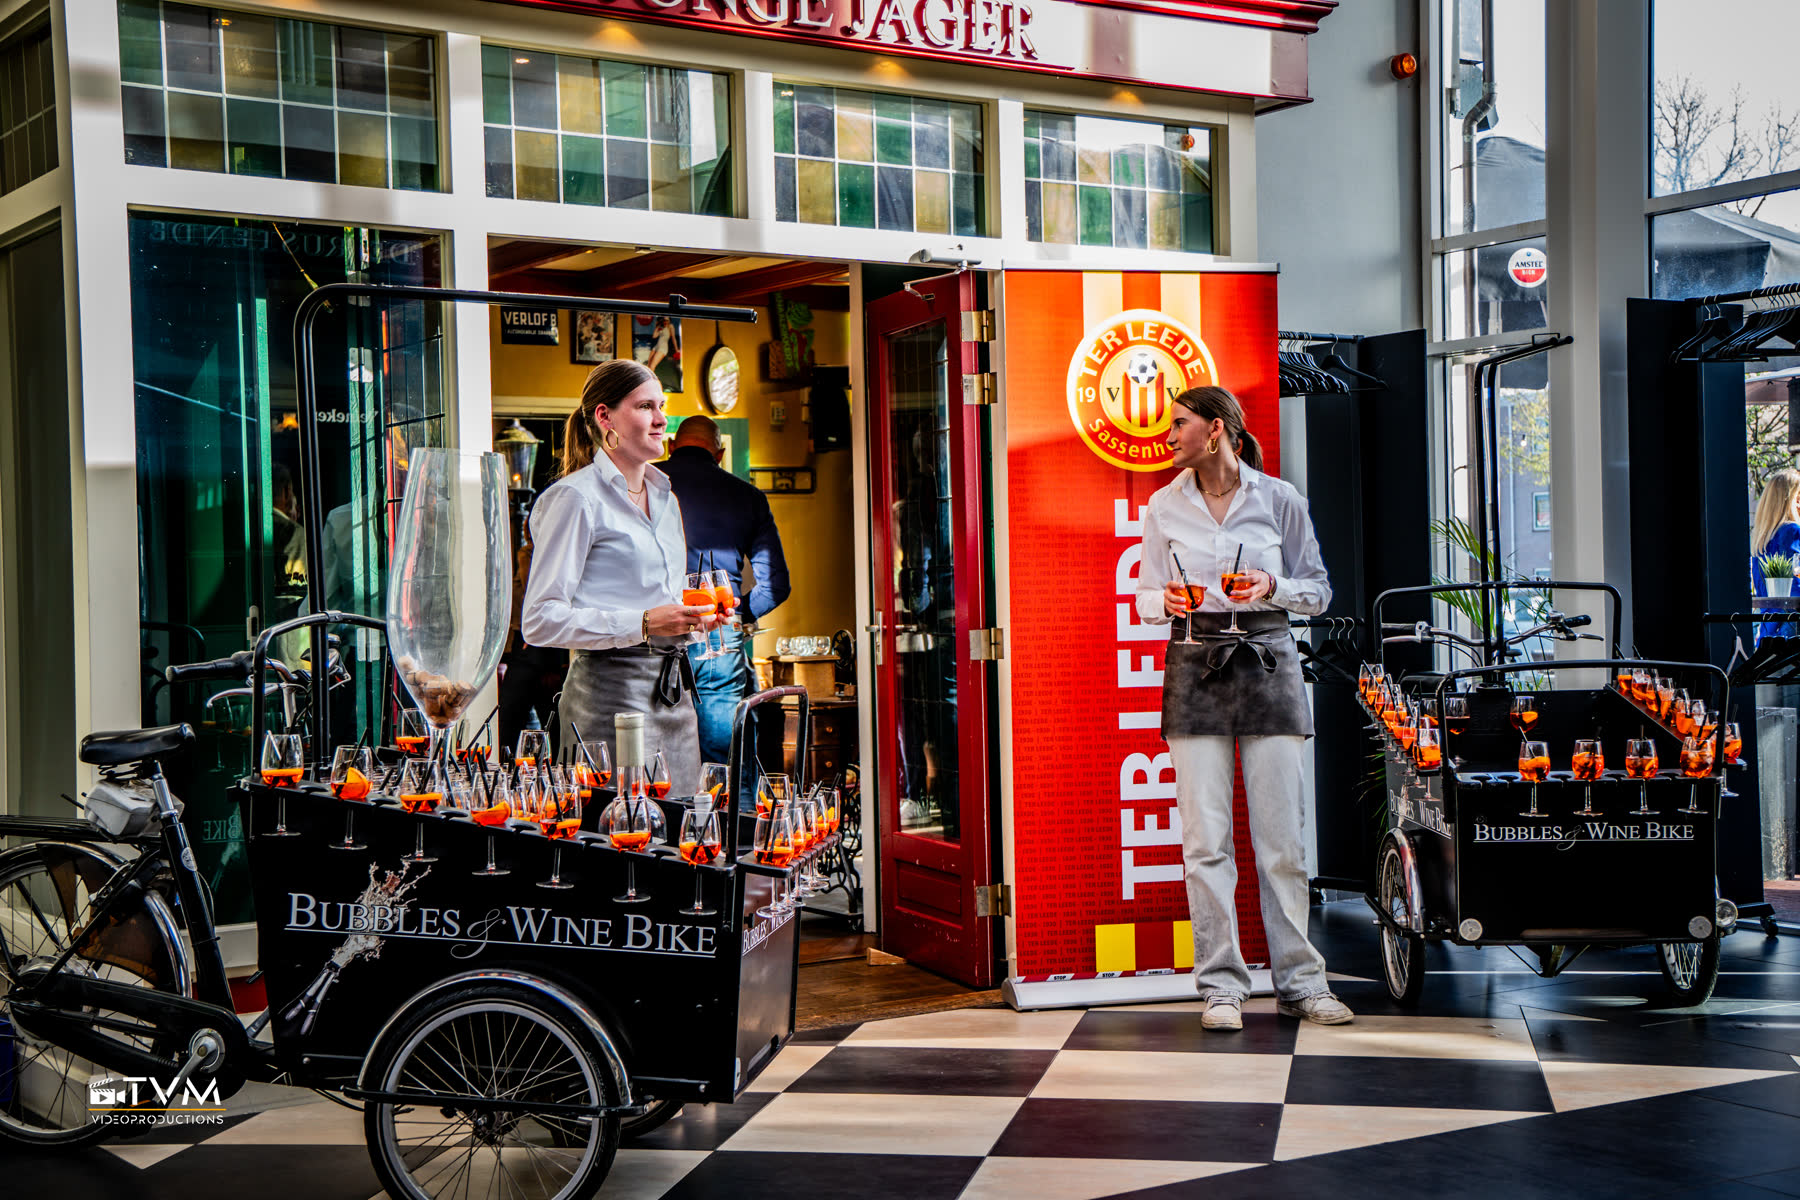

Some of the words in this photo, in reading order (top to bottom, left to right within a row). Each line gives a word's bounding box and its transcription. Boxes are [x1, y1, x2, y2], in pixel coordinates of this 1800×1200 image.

[848, 0, 1038, 57] JAGER
[503, 311, 548, 326] VERLOF
[1079, 329, 1124, 377] TER
[1125, 322, 1206, 380] LEEDE
[1077, 386, 1097, 403] 19
[1106, 387, 1120, 402] V
[1089, 418, 1173, 459] Sassenh
[1474, 823, 1563, 841] BUBBLES
[1584, 822, 1641, 840] WINE
[1645, 822, 1695, 840] BIKE
[285, 892, 461, 938] BUBBLES
[506, 906, 613, 948] WINE
[622, 913, 718, 955] BIKE
